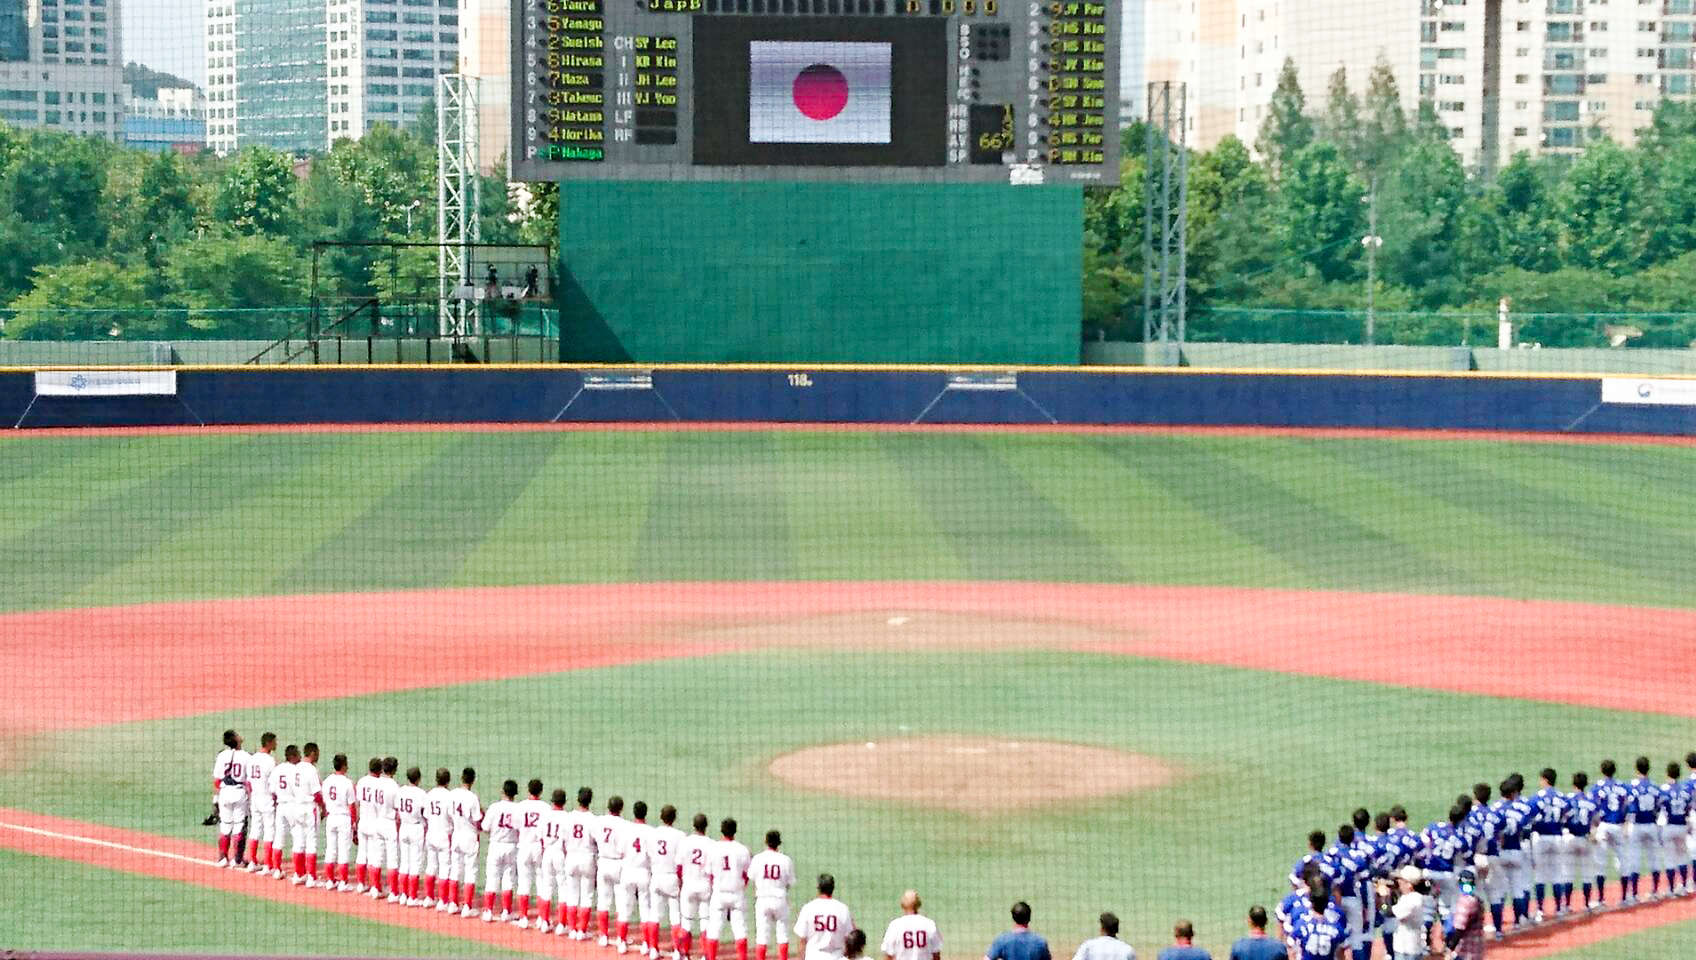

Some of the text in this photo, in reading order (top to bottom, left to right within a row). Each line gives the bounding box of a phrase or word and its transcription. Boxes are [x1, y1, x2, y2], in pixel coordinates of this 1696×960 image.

[1030, 2, 1040, 16] 2
[528, 16, 536, 30] 3
[1030, 21, 1039, 36] 3
[527, 34, 536, 49] 4
[614, 36, 633, 49] CH
[1030, 39, 1039, 54] 4
[527, 53, 536, 67] 5
[528, 71, 536, 85] 6
[528, 89, 536, 104] 7
[1028, 94, 1038, 109] 7
[527, 108, 536, 123] 8
[527, 126, 536, 141] 9
[548, 126, 560, 142] 4
[527, 145, 537, 159] P
[224, 762, 242, 778] 20
[279, 775, 288, 790] 5
[400, 797, 414, 814] 16
[430, 801, 442, 816] 15
[453, 801, 464, 817] 14
[524, 812, 540, 828] 12
[547, 822, 560, 840] 11
[573, 824, 584, 839] 8
[603, 827, 613, 843] 7
[632, 837, 642, 853] 4
[657, 840, 668, 856] 3
[692, 849, 703, 866] 2
[722, 855, 732, 871] 1
[763, 864, 781, 881] 10
[814, 915, 838, 932] 50
[902, 930, 928, 949] 60
